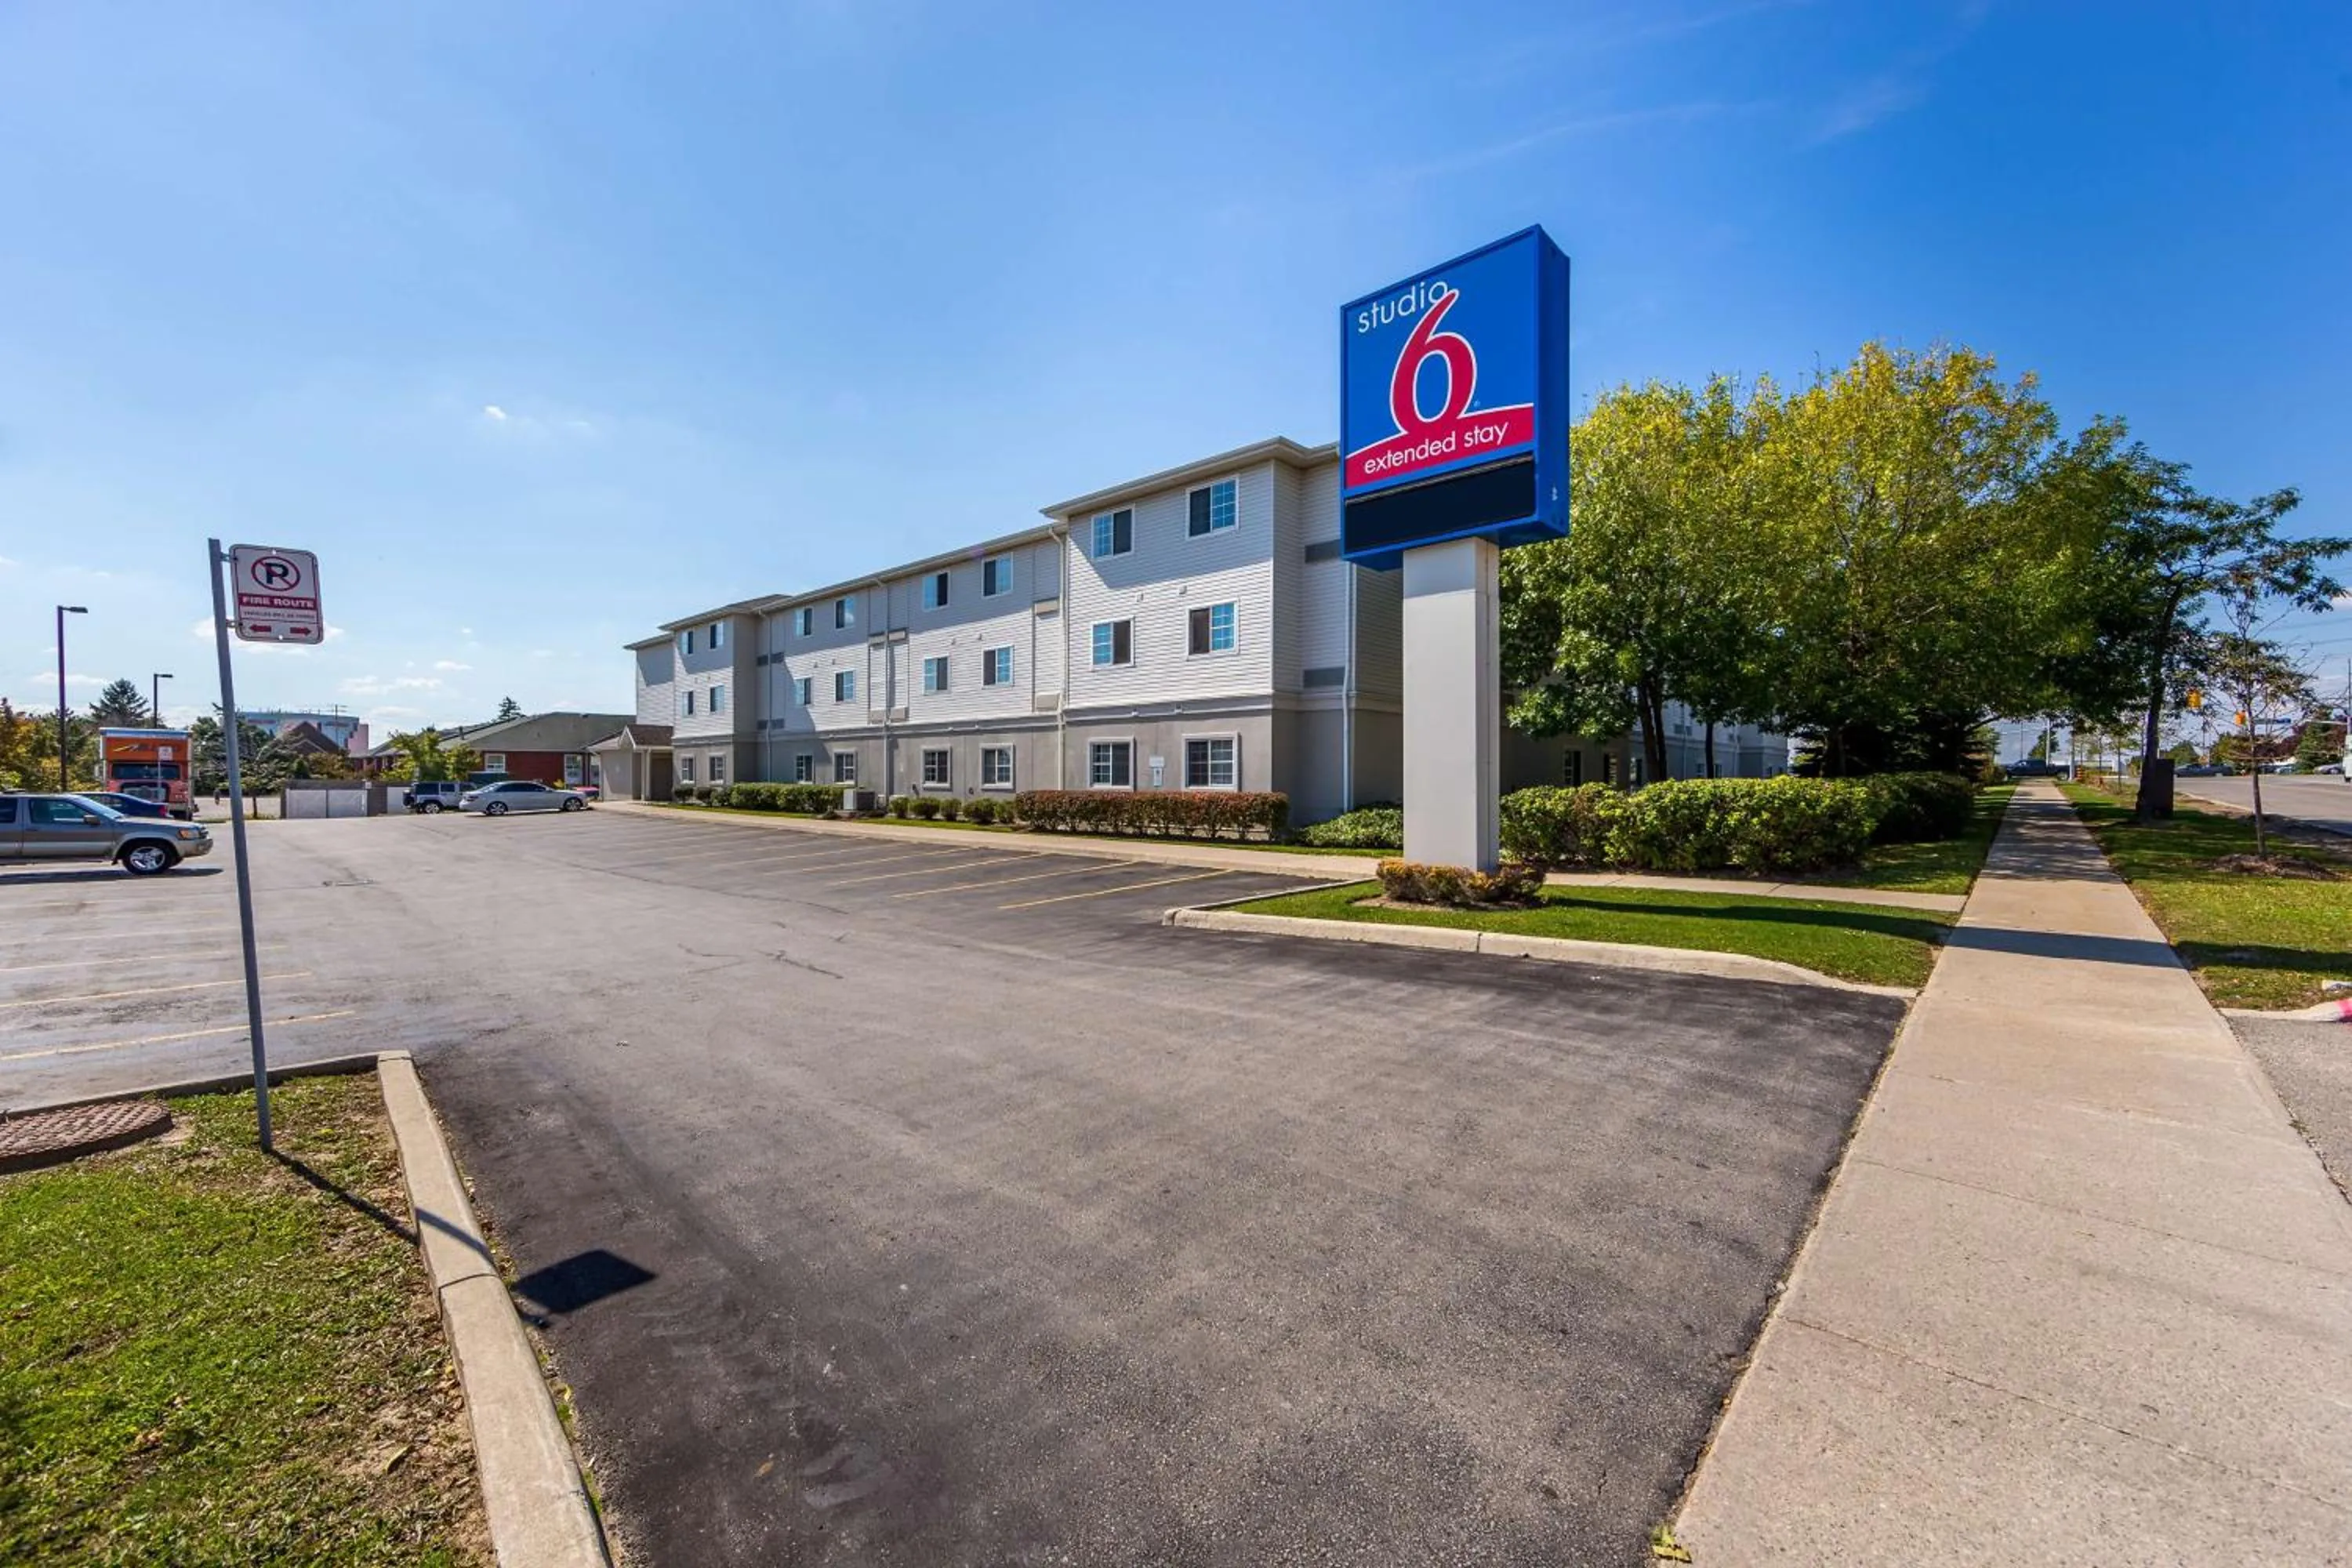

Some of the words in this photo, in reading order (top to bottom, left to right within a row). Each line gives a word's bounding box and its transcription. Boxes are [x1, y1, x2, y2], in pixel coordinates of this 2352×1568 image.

[1358, 281, 1448, 333] studio
[1390, 289, 1477, 428] 6
[1364, 430, 1456, 474] extended
[1464, 422, 1508, 448] stay
[242, 596, 270, 605] FIRE
[274, 598, 314, 608] ROUTE
